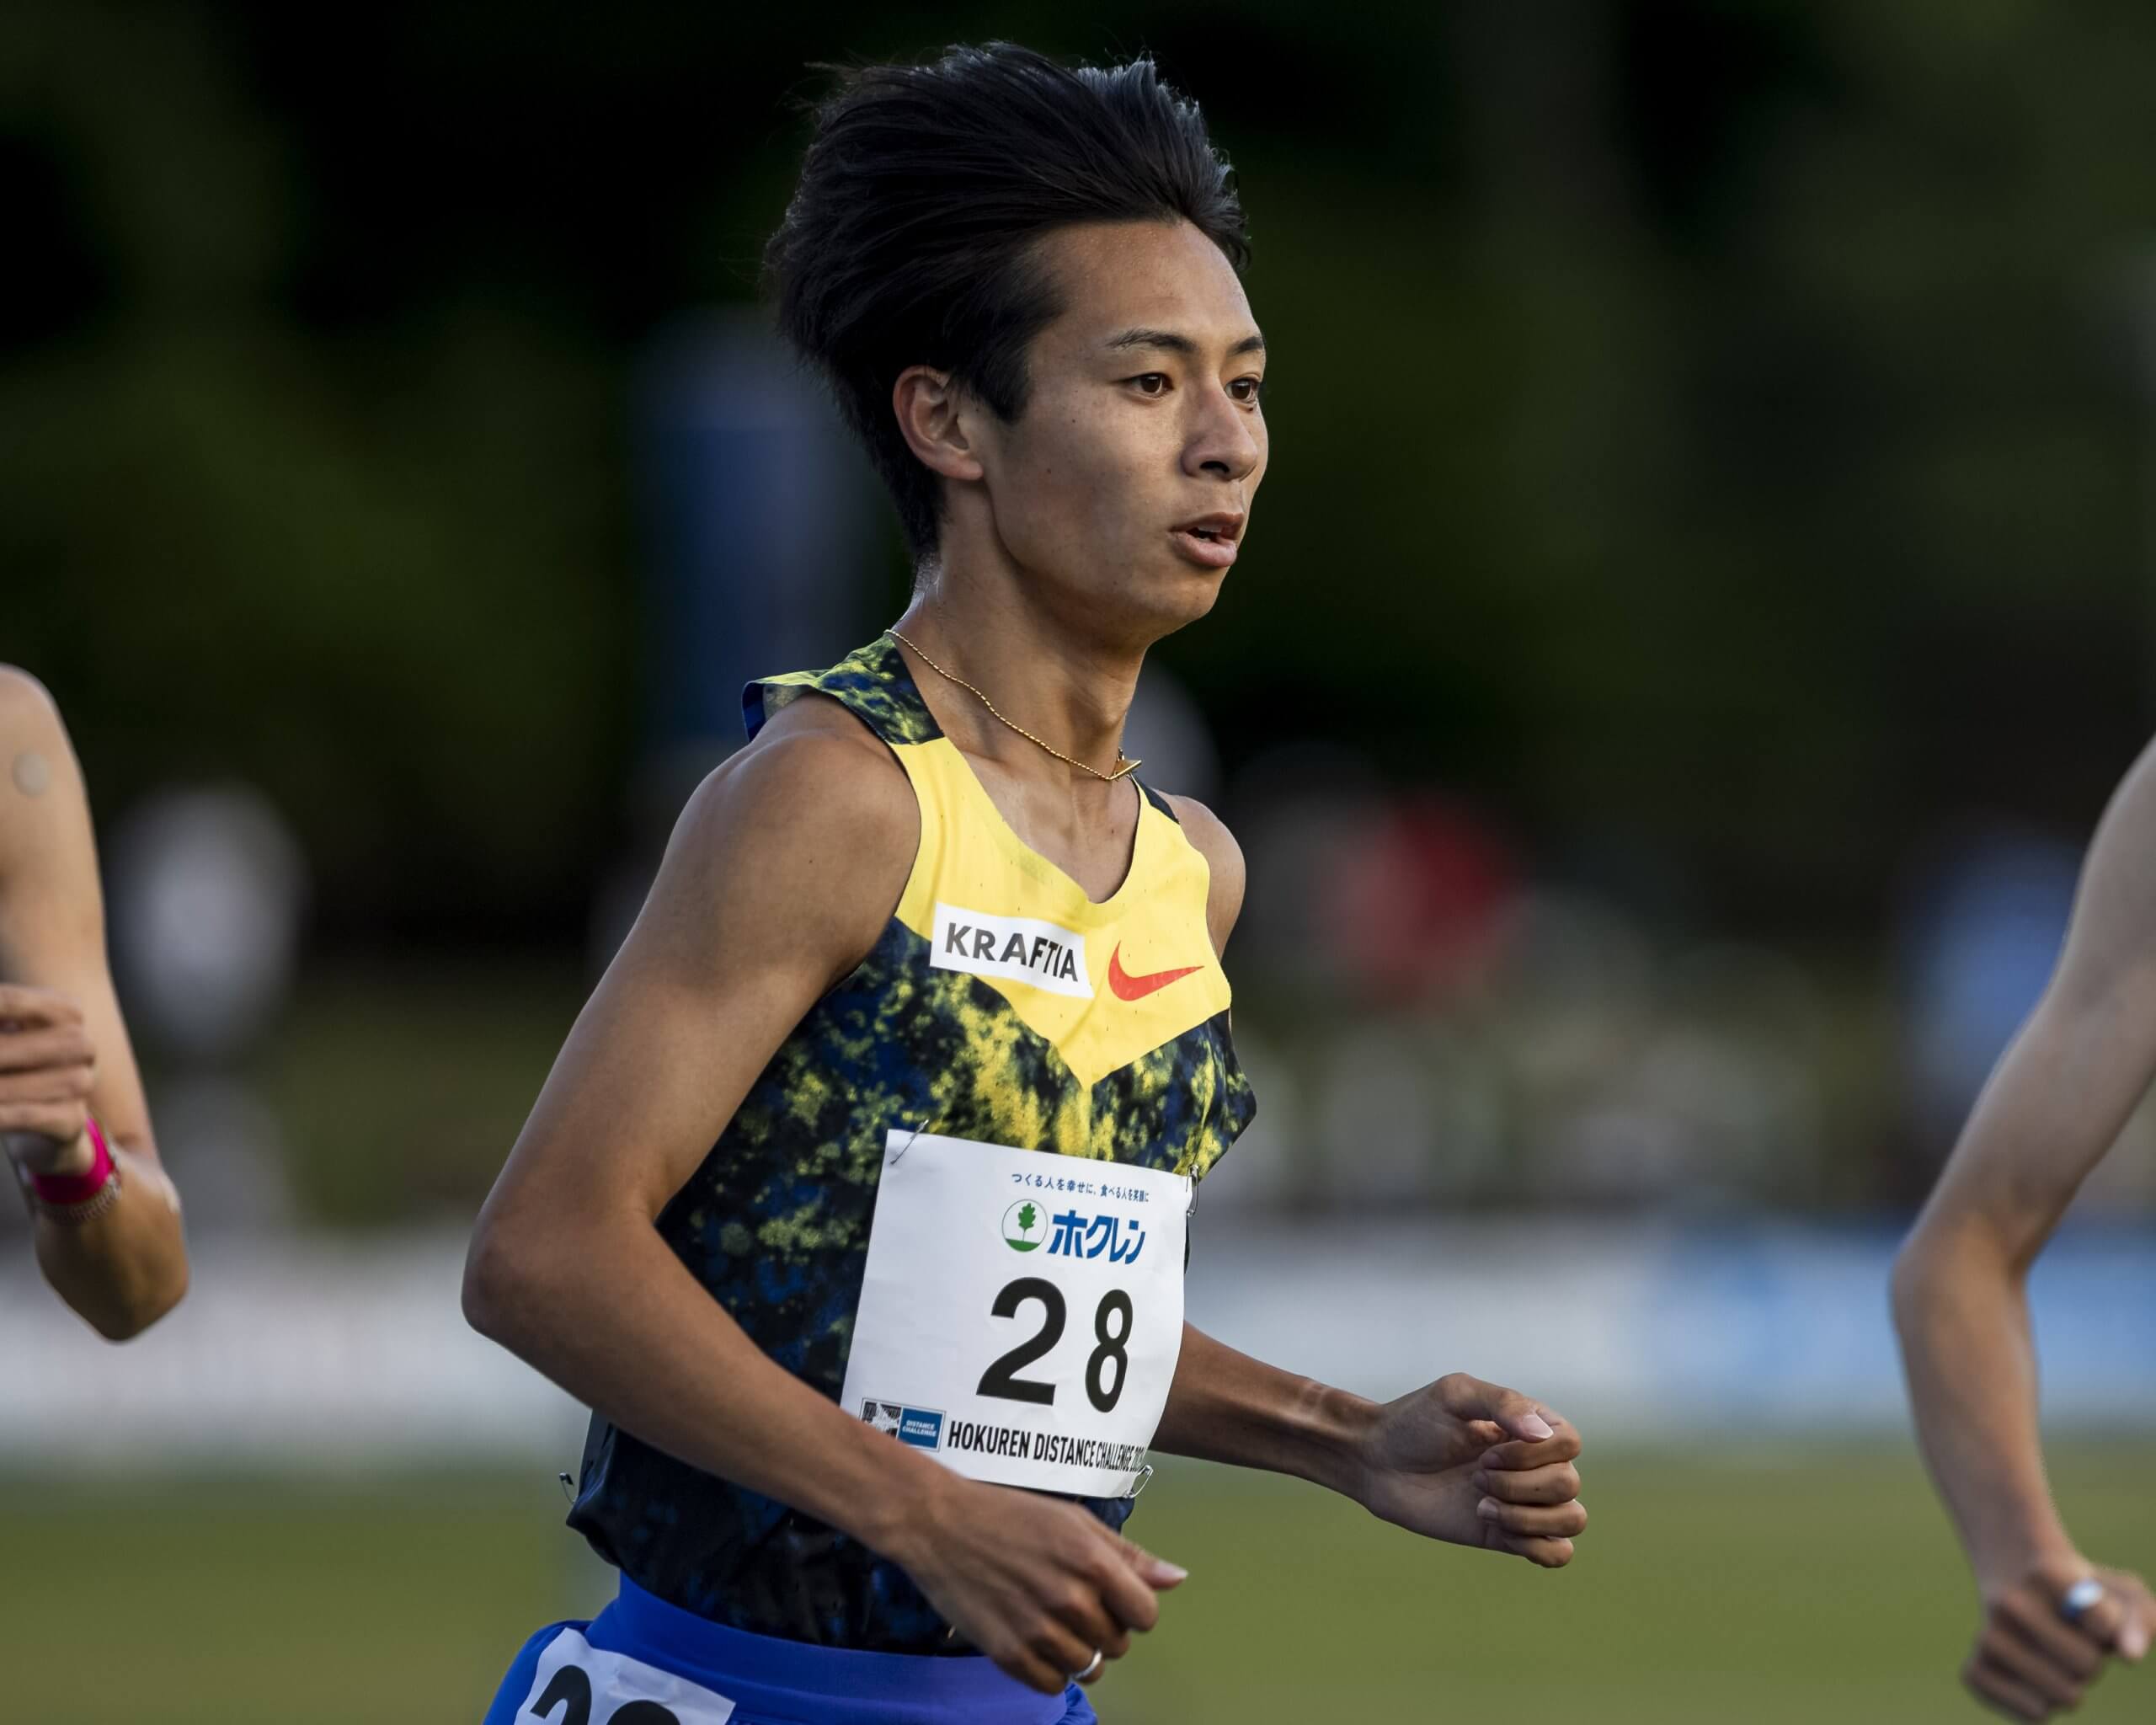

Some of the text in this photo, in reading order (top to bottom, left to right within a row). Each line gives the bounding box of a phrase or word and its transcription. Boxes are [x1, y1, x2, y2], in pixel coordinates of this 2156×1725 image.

[945, 922, 1078, 982] KRAFTIA
[1047, 1210, 1146, 1264] ホクレン
[976, 1276, 1134, 1413] 28
[902, 1425, 937, 1438] CHALLENGE
[905, 1419, 936, 1430] DISTANCE
[947, 1420, 1031, 1458] HOKUREN
[1033, 1433, 1097, 1467] DISTANCE
[1096, 1441, 1135, 1472] CHALLENGE
